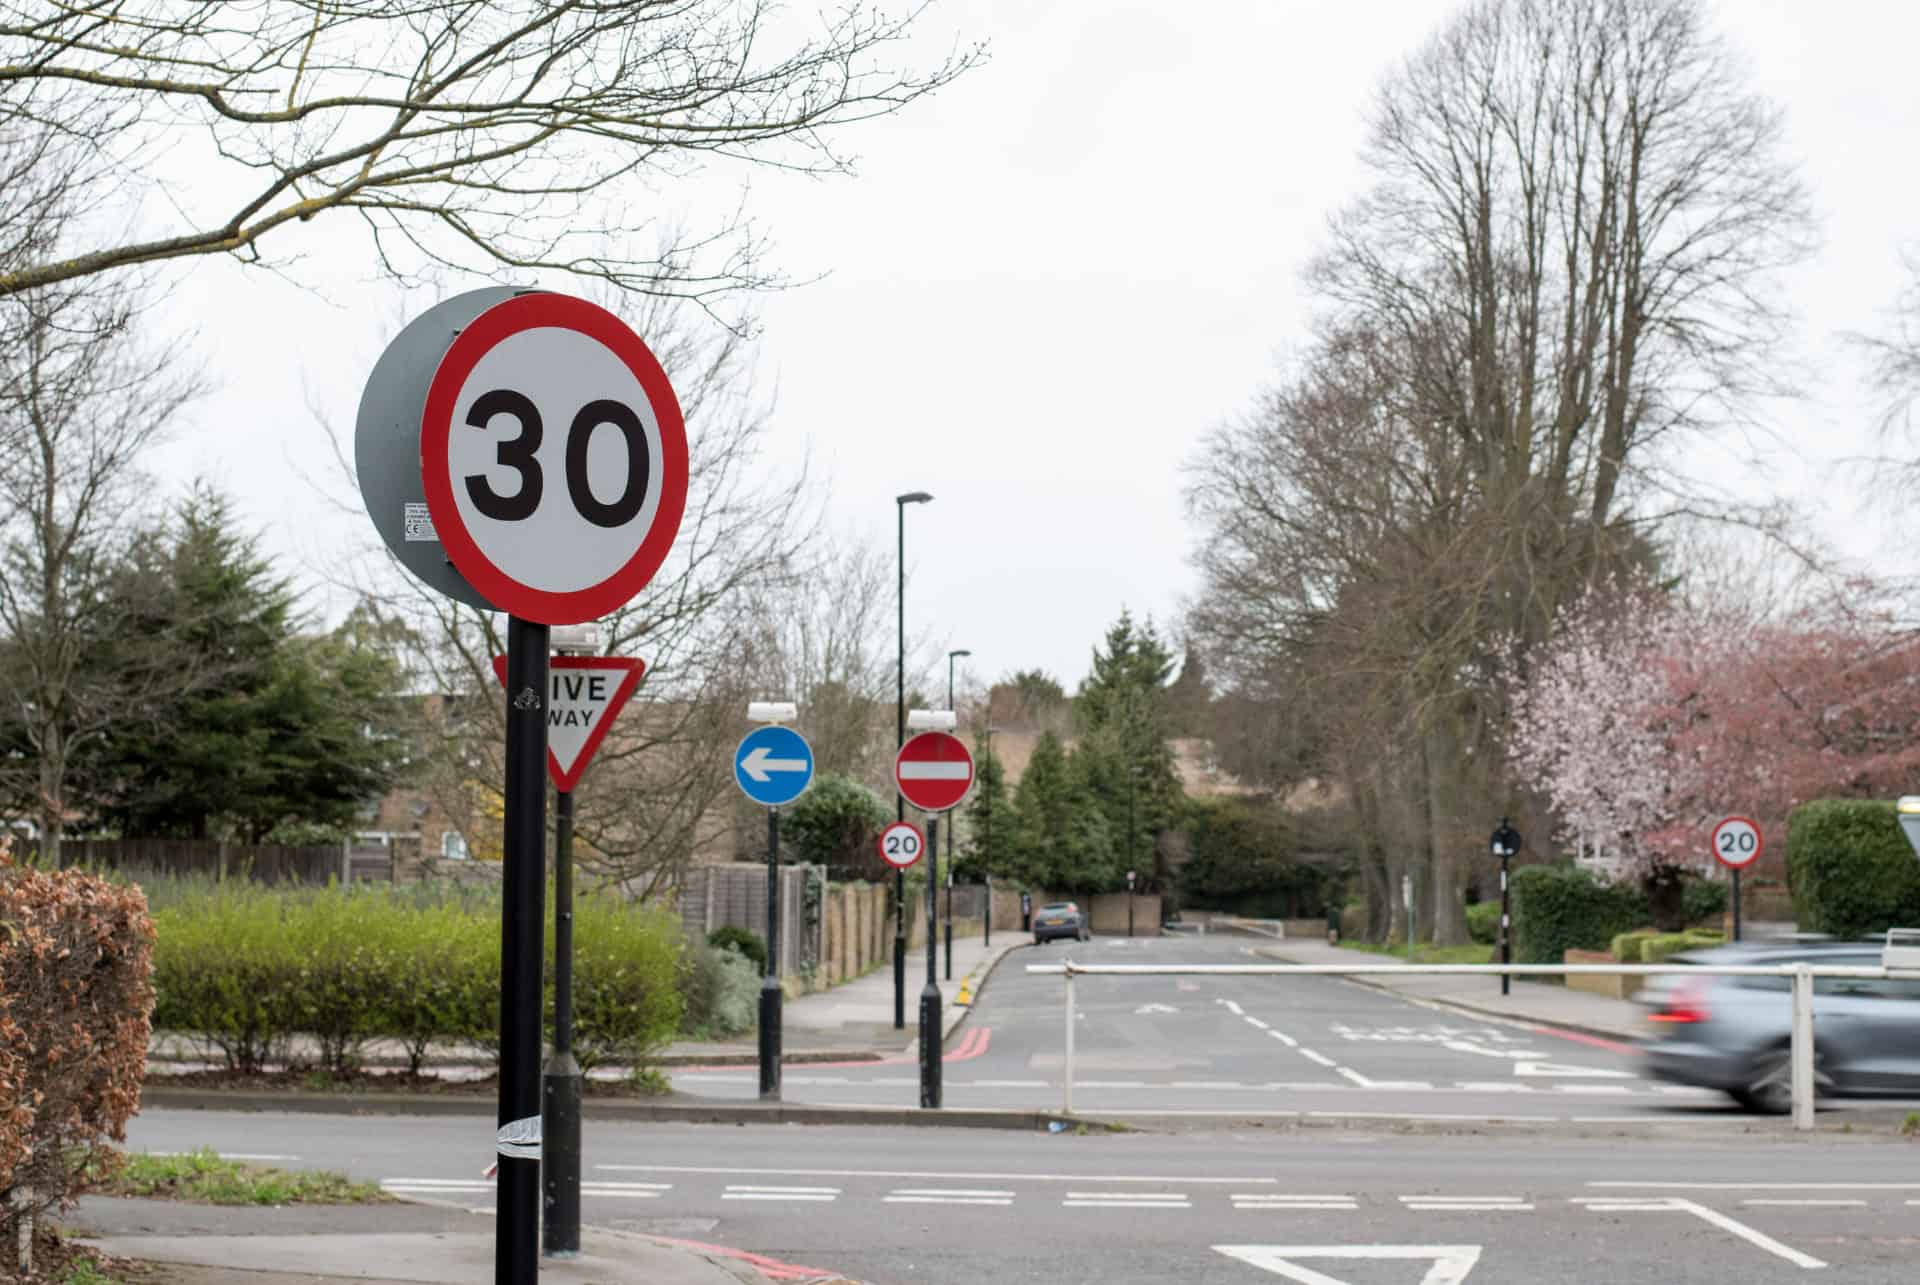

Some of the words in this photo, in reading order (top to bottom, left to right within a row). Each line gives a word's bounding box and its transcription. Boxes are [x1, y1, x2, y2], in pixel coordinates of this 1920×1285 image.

[464, 388, 651, 528] 30
[552, 675, 607, 701] IVE
[887, 836, 917, 854] 20
[1720, 831, 1755, 852] 20
